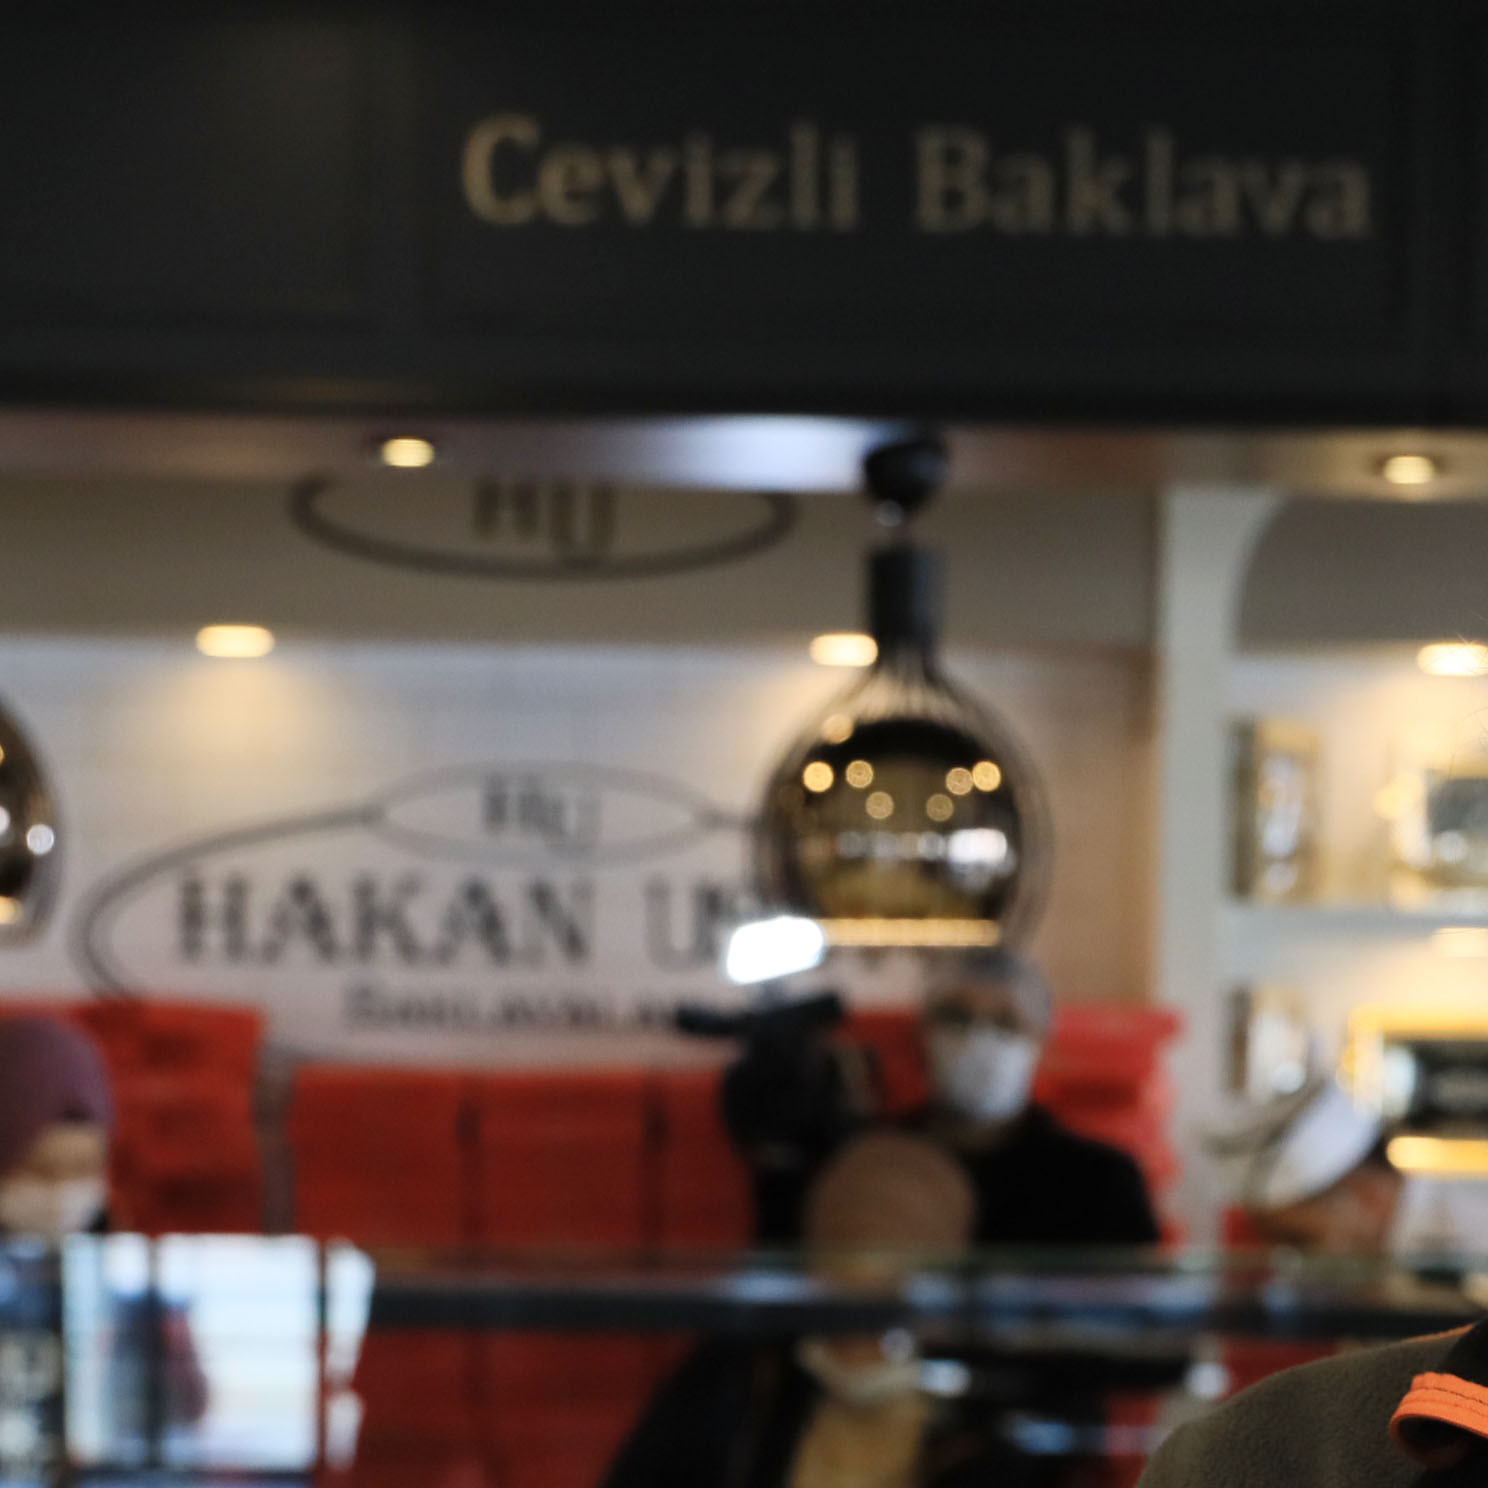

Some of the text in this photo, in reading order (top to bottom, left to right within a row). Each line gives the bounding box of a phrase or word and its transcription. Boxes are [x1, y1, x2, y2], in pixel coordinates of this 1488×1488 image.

[460, 112, 1372, 240] Cevizli Baklava
[176, 870, 598, 966] HAKAN
